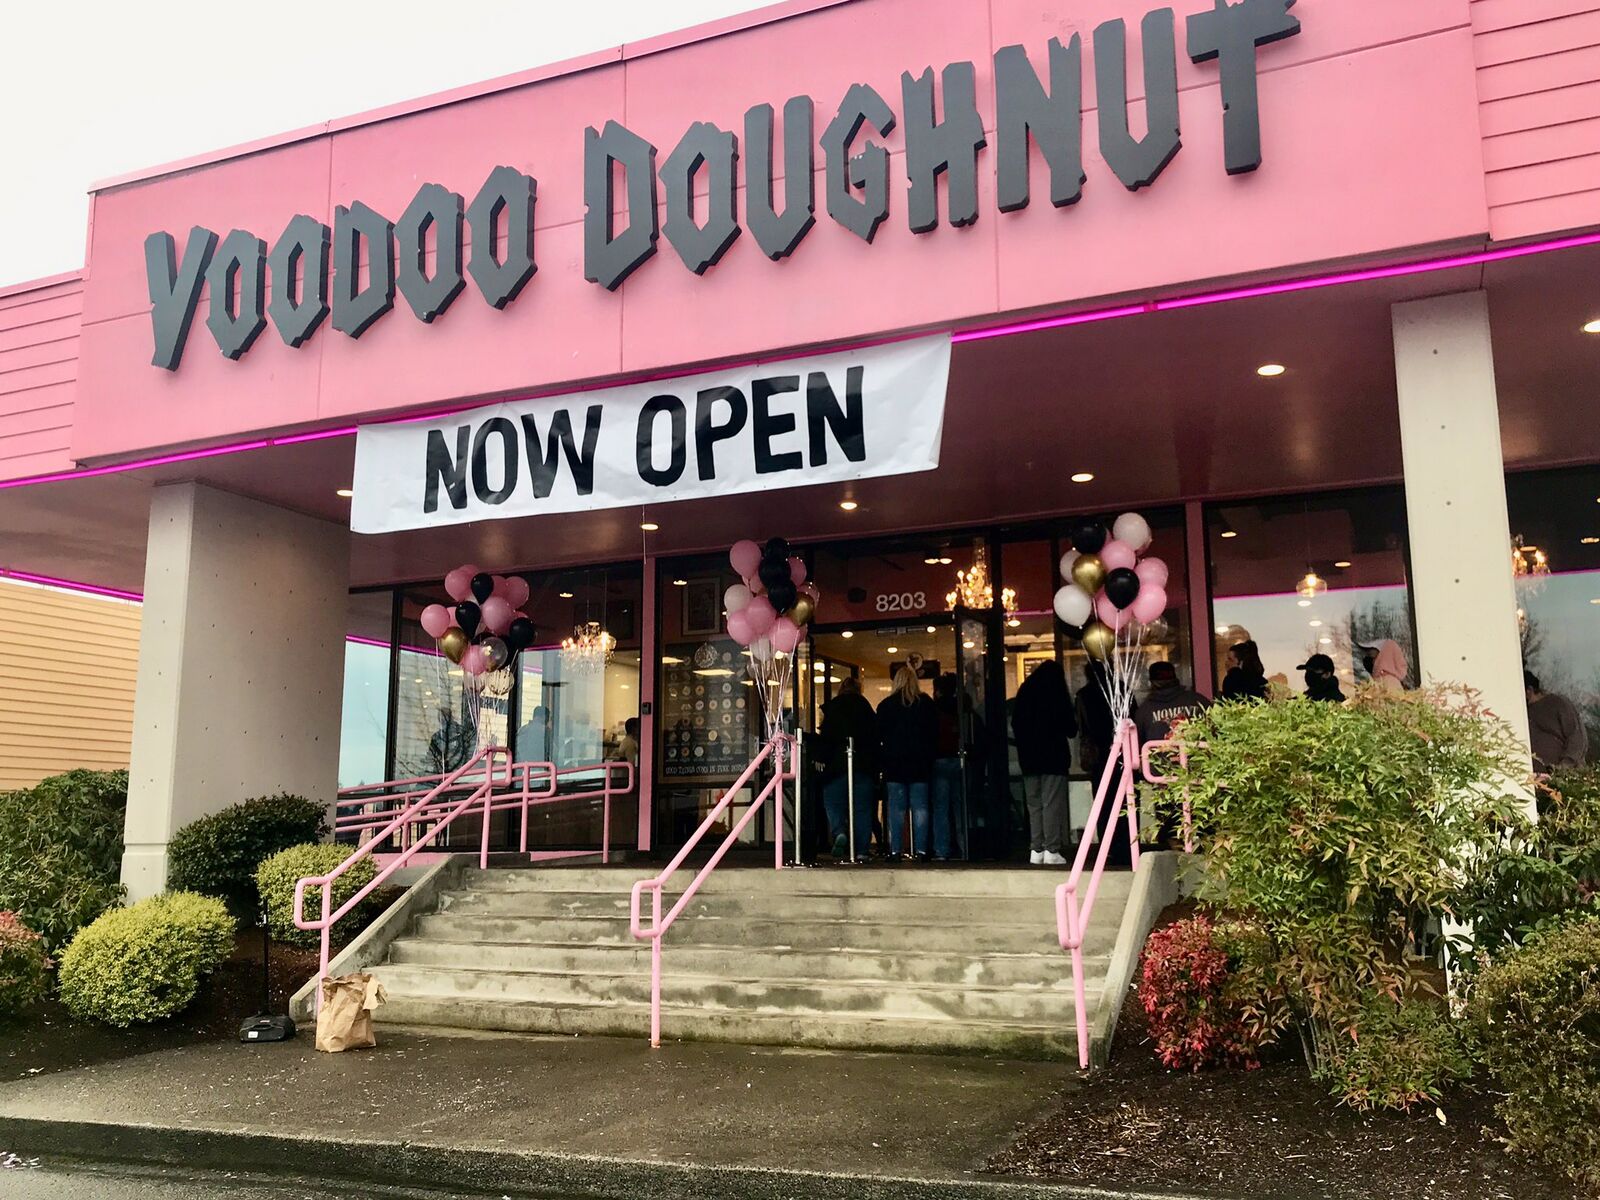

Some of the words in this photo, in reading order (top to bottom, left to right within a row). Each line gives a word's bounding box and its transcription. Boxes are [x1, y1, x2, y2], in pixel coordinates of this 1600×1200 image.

[144, 165, 538, 372] VOODOO
[584, 0, 1302, 291] DOUGHNUT
[423, 404, 603, 514] NOW
[636, 365, 866, 486] OPEN
[876, 591, 926, 612] 8203
